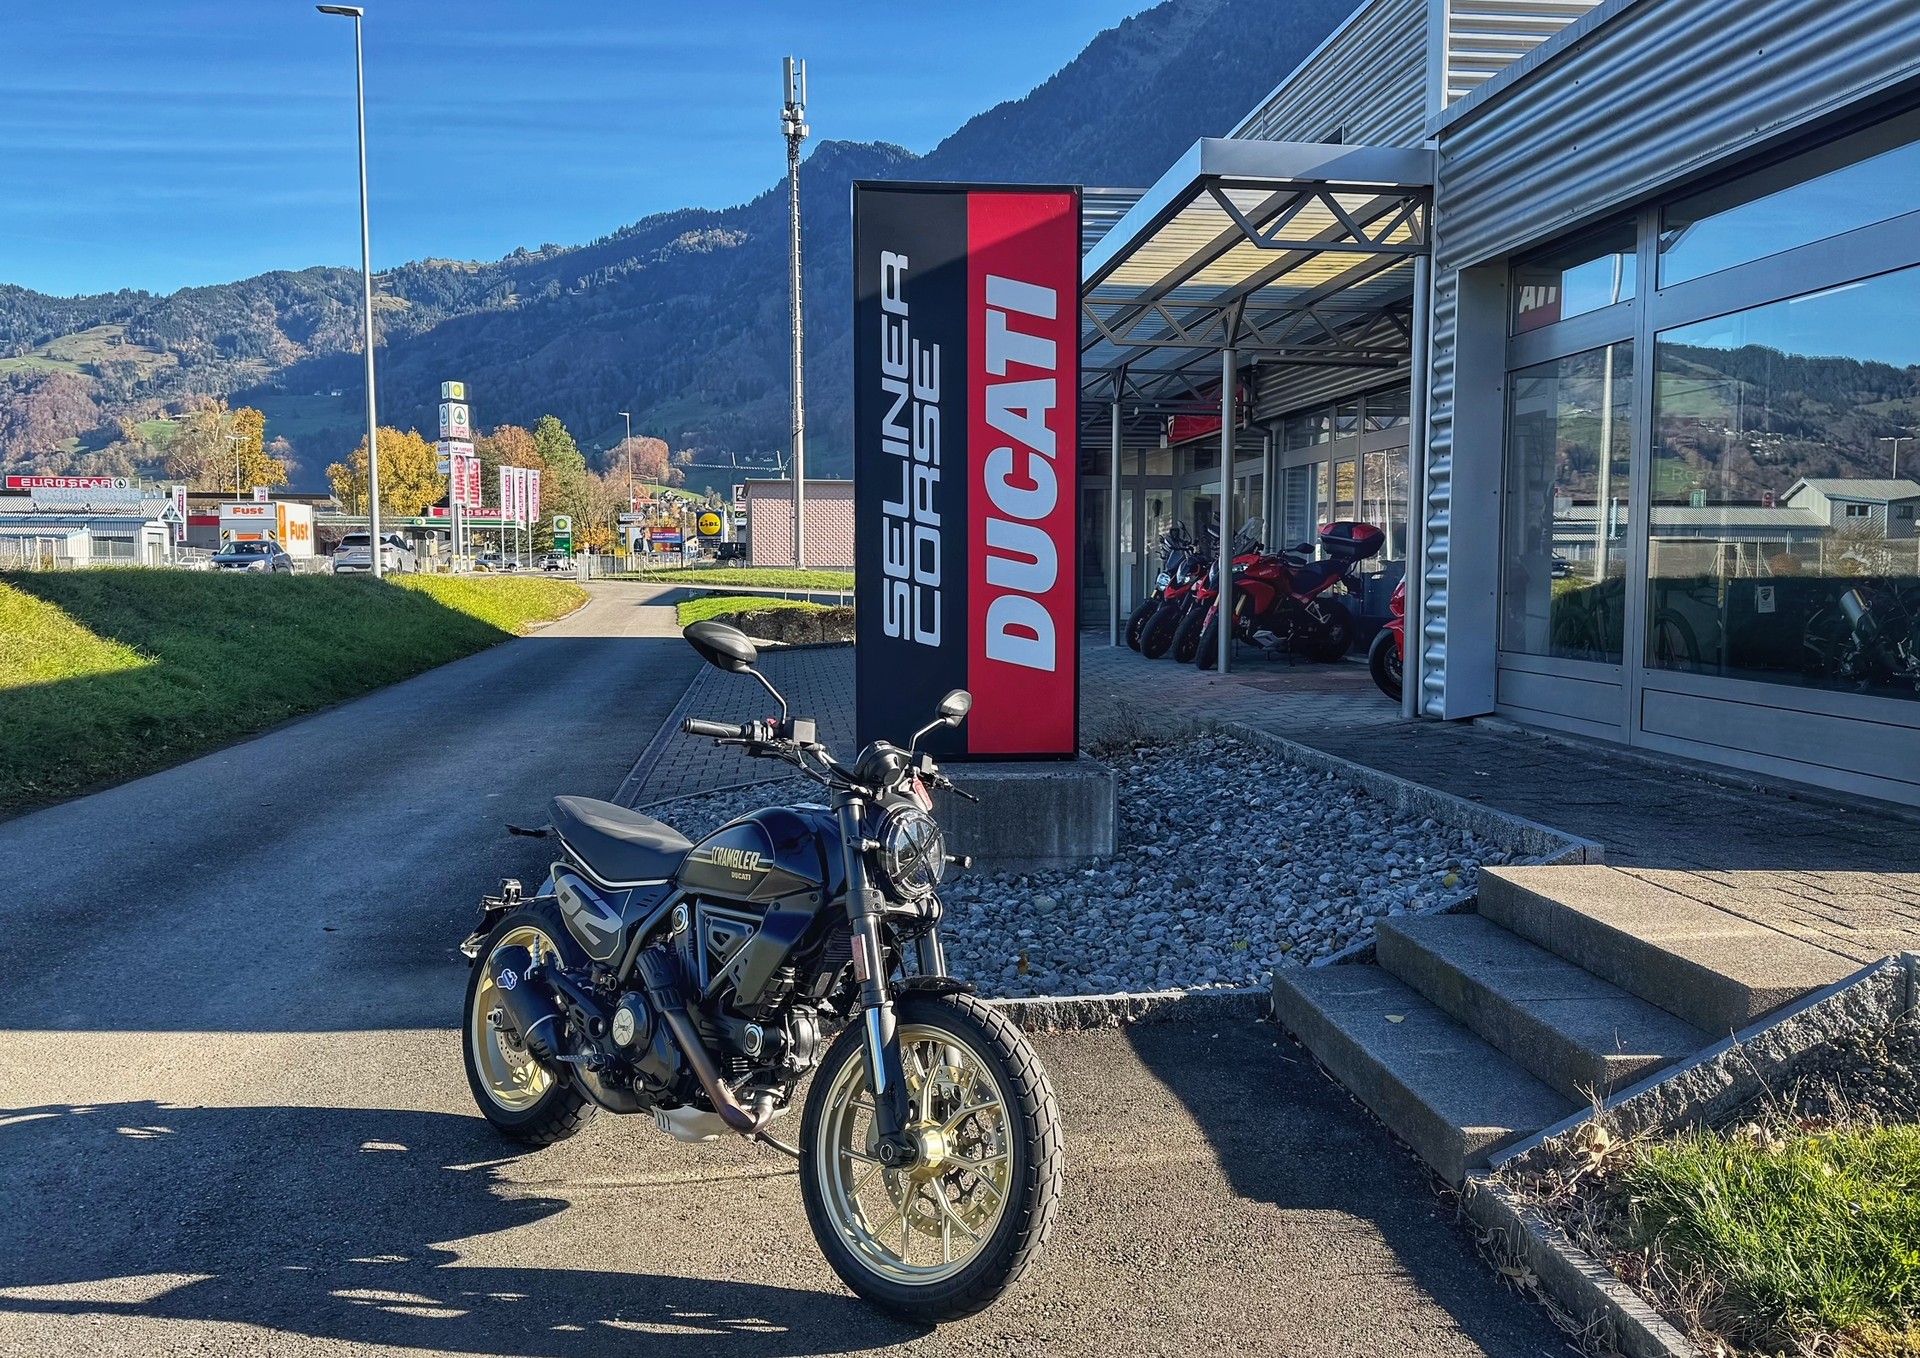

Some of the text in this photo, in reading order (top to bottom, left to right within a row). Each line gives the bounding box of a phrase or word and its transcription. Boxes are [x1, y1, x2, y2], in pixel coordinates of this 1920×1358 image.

[880, 250, 910, 640] SELINER
[21, 478, 111, 488] EUROSPAR
[454, 455, 465, 503] JUMBO
[469, 461, 480, 506] JUMBO
[983, 273, 1058, 672] DUCATI
[912, 338, 941, 648] CORSE
[232, 507, 264, 515] Fust
[290, 521, 308, 540] Fust
[711, 846, 761, 871] SCRAMBLER
[731, 871, 751, 881] DUCATI
